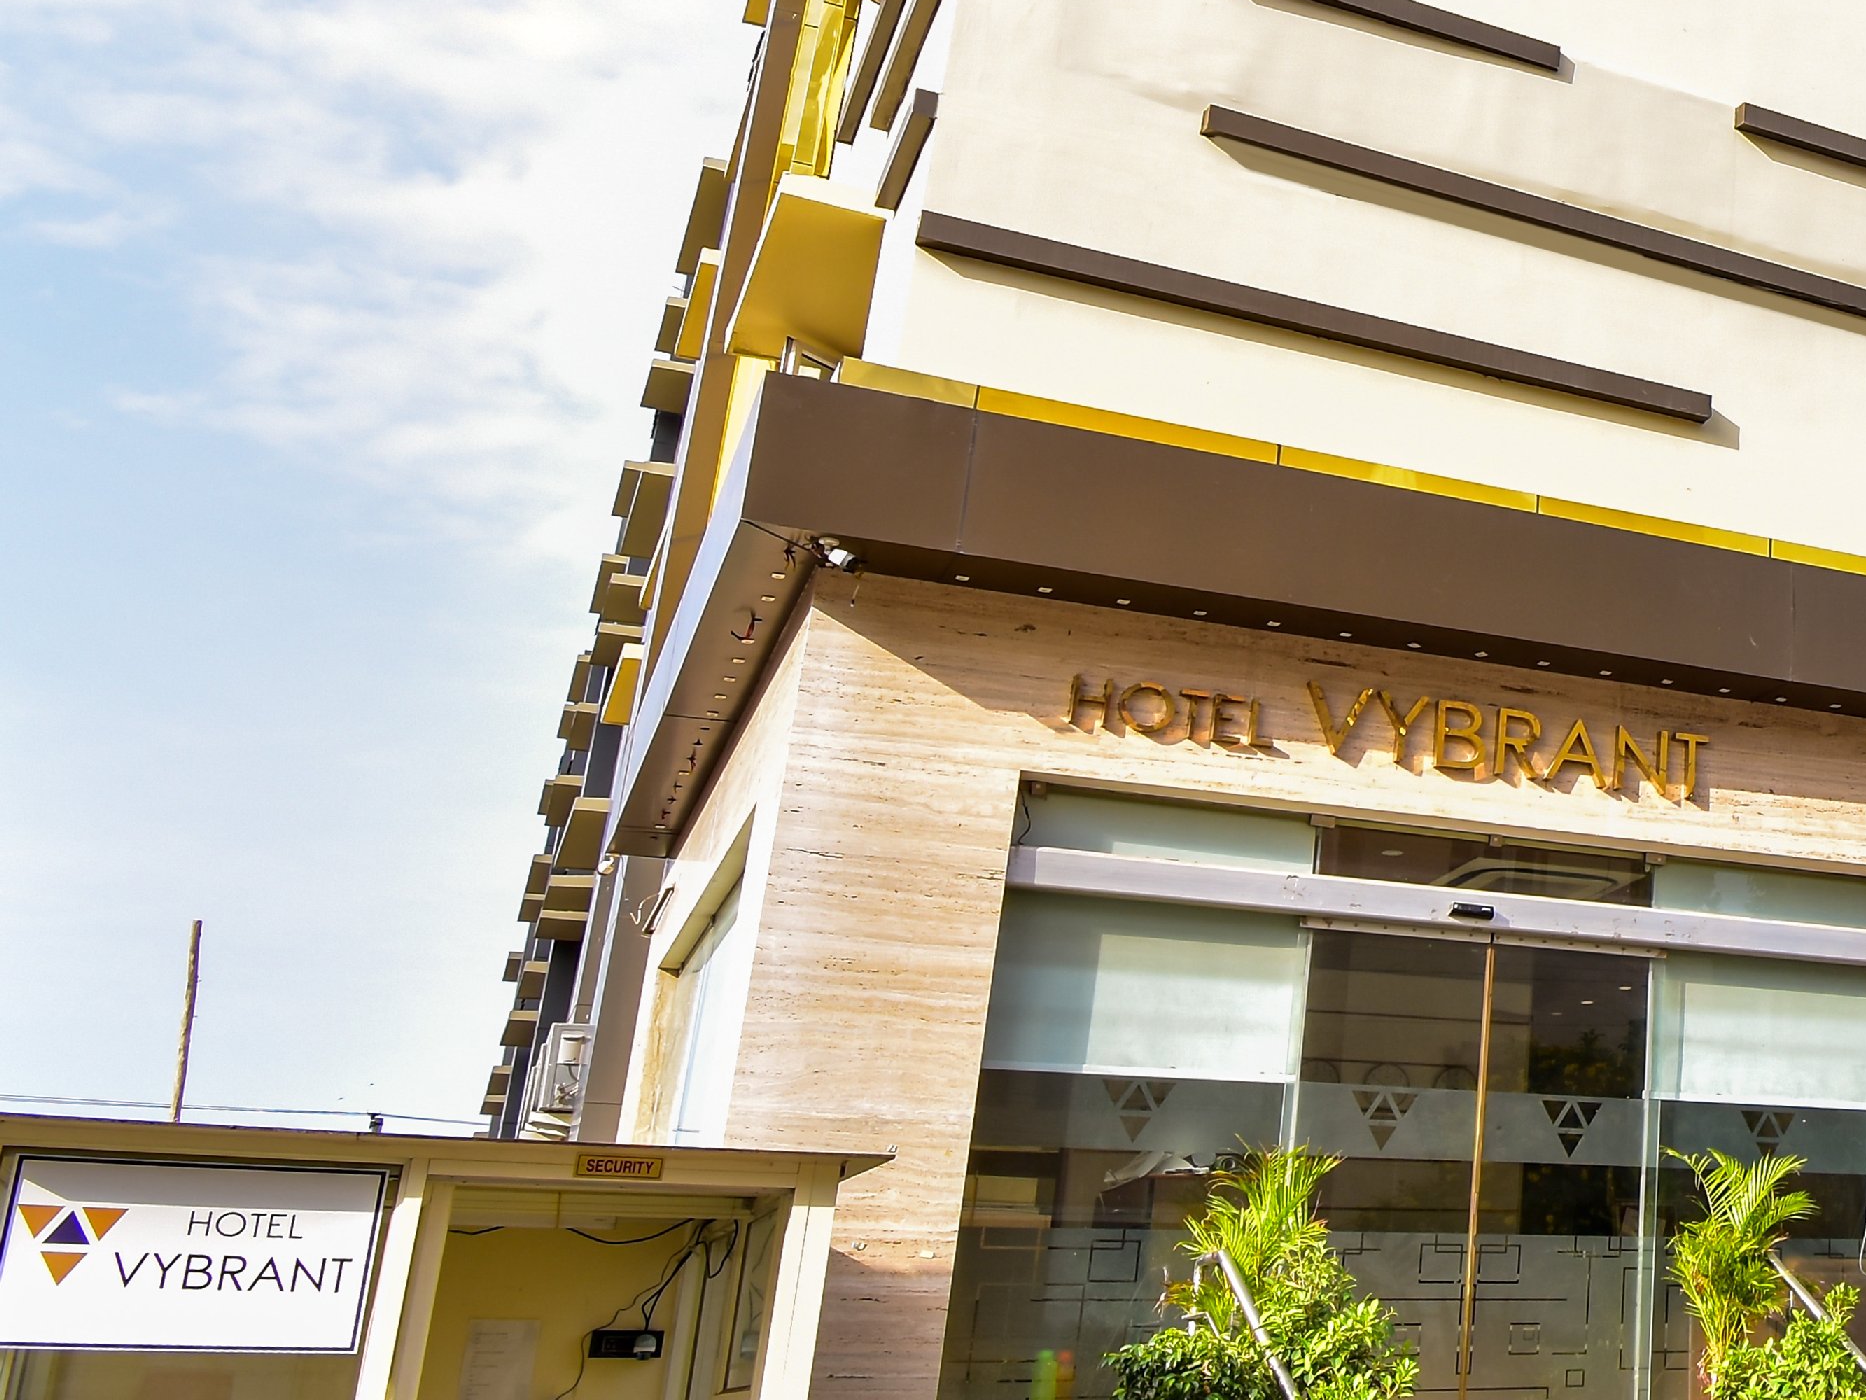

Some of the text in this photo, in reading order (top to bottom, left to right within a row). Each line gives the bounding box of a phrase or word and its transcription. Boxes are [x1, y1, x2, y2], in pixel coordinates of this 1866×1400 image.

[1067, 673, 1710, 800] HOTEL VYBRANT
[585, 1159, 654, 1174] SECURITY
[187, 1210, 303, 1239] HOTEL
[115, 1252, 353, 1293] VYBRANT
